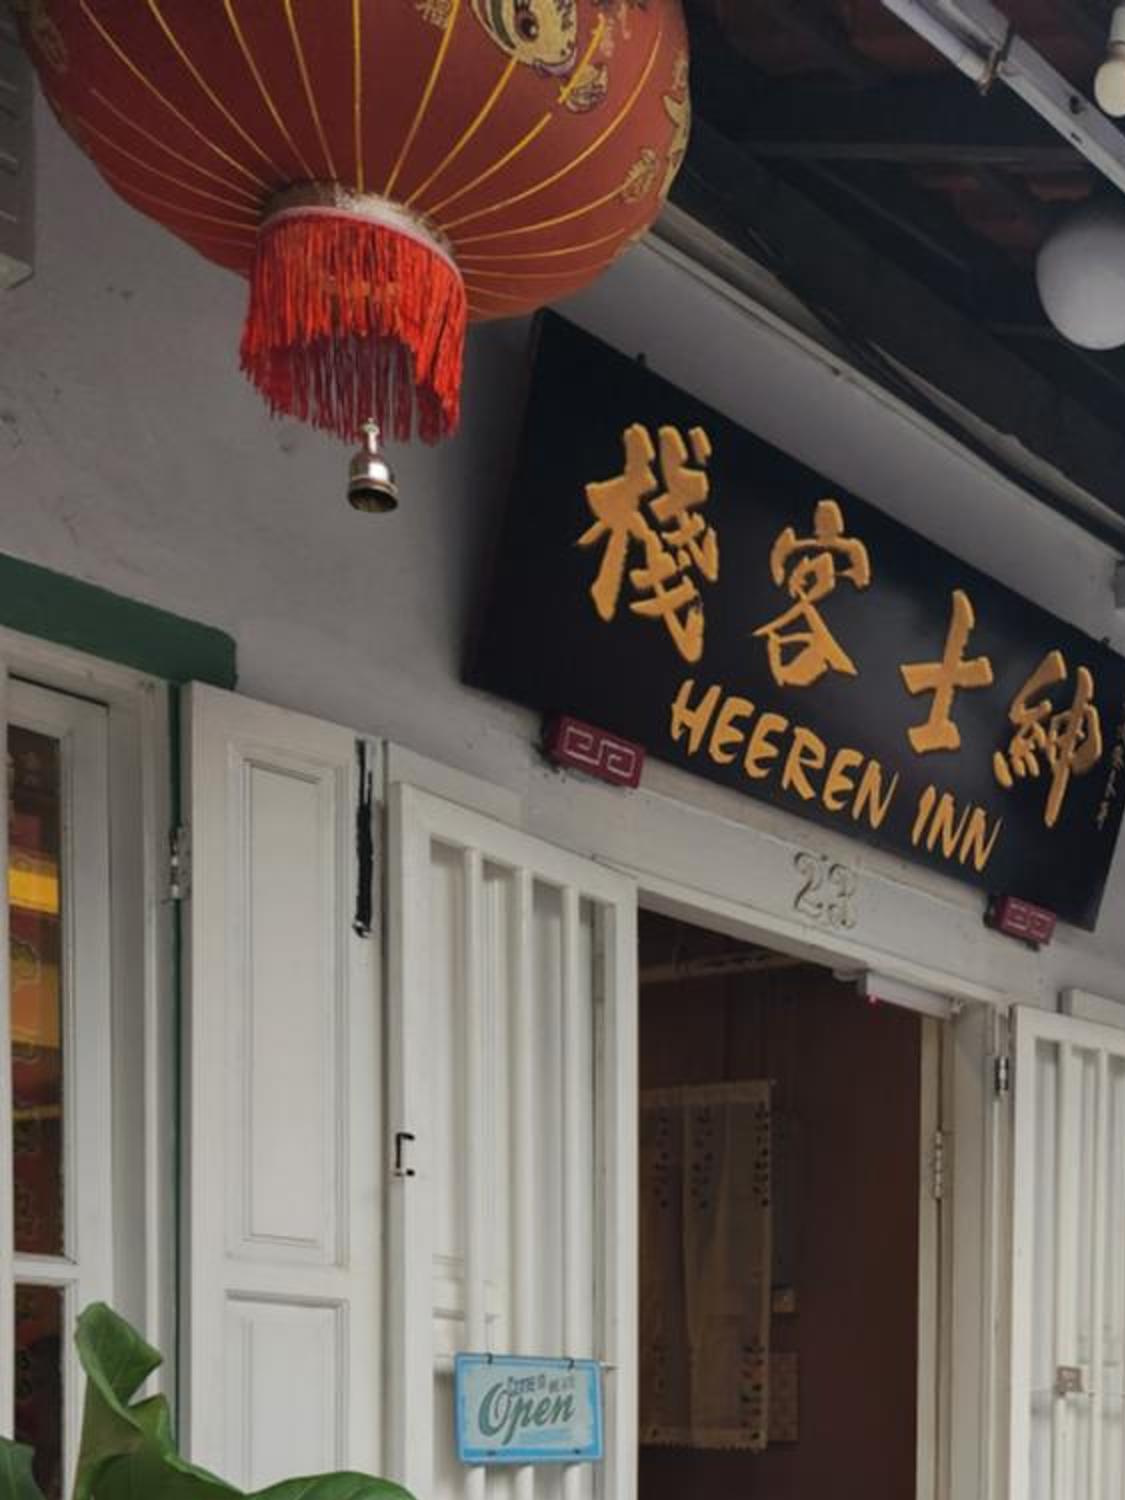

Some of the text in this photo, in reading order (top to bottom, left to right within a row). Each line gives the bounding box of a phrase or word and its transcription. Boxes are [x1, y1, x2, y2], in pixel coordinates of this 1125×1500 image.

[670, 680, 1001, 872] HEEREN INN
[478, 1381, 577, 1446] Open
